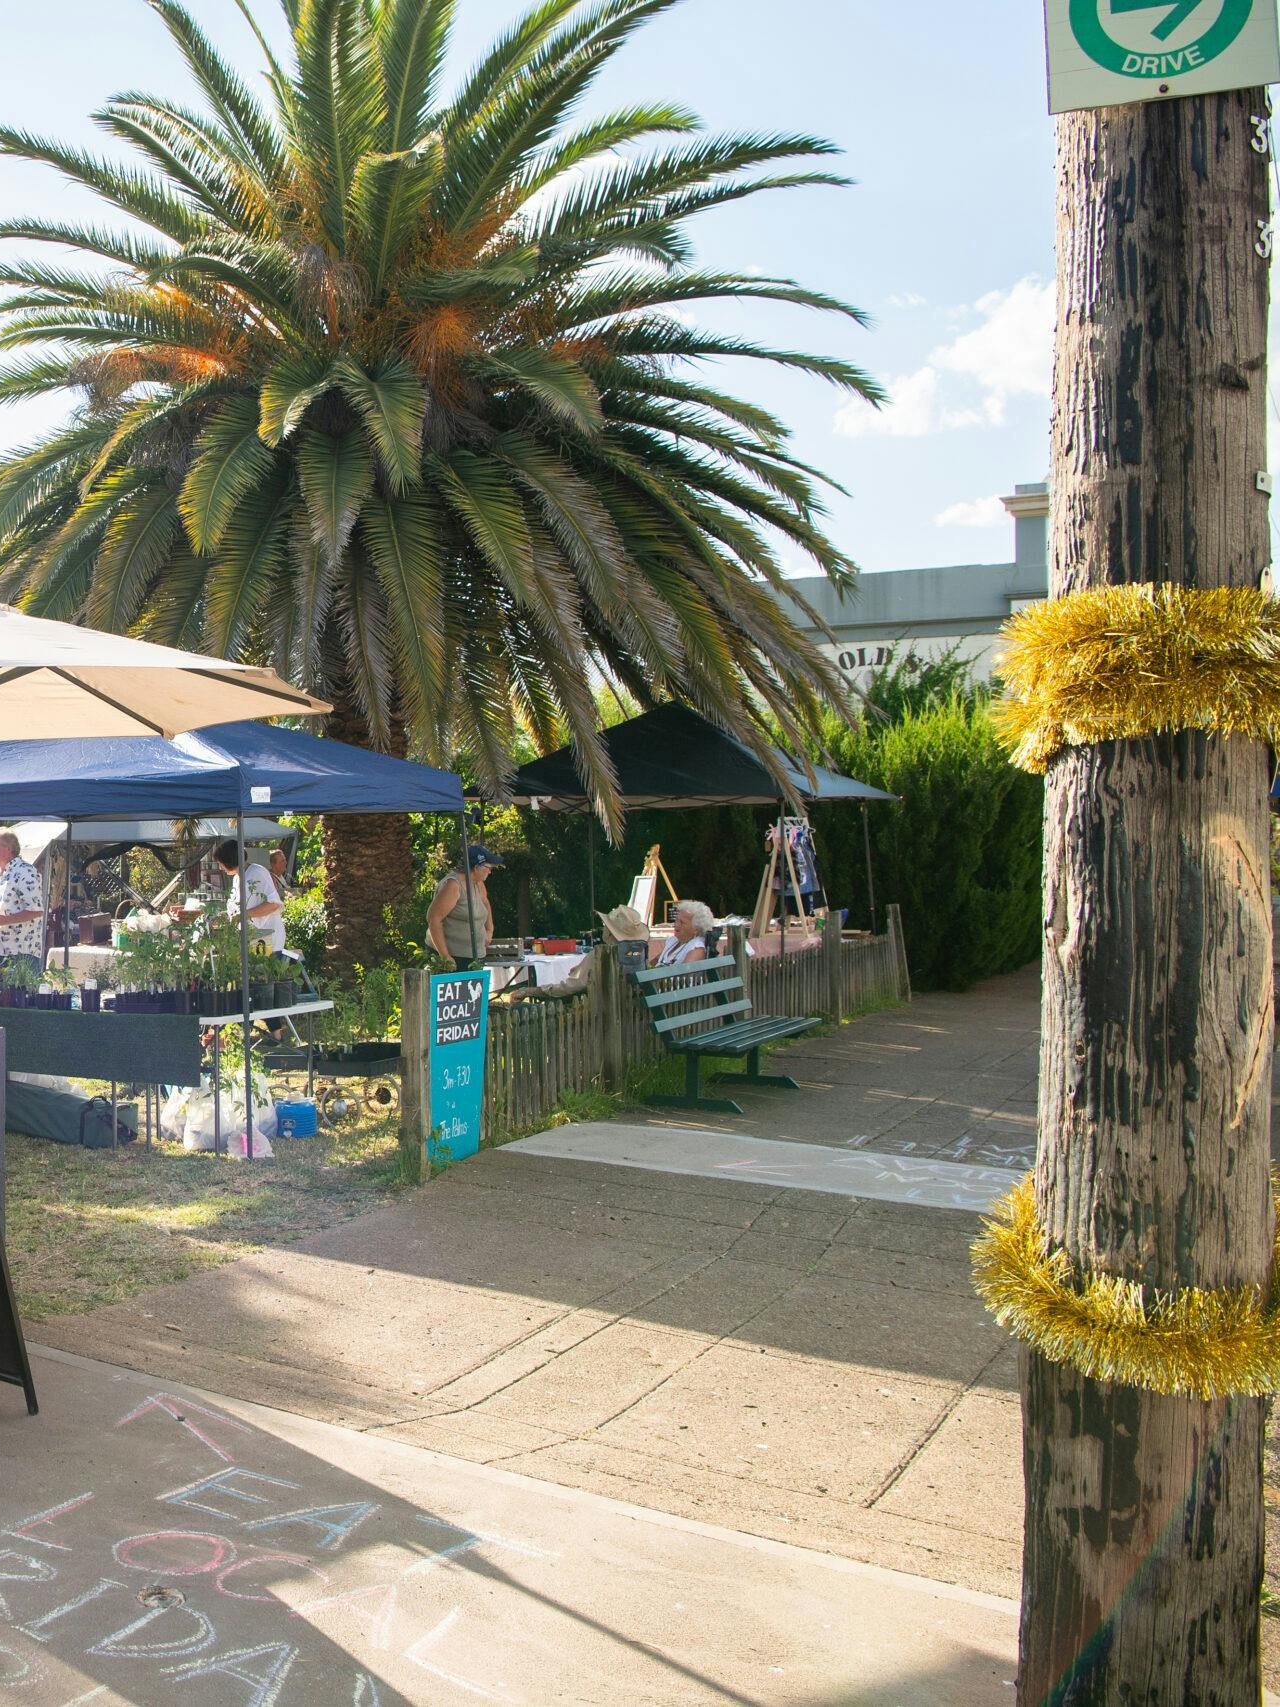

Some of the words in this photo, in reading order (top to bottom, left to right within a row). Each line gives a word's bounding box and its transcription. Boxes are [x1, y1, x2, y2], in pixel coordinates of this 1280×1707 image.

[1122, 45, 1205, 74] DRIVE
[437, 982, 462, 1003] EAT
[436, 1002, 471, 1023] LOCAL
[436, 1022, 479, 1044] FRIDAY
[156, 1465, 562, 1580] EAT
[0, 1490, 520, 1704] LOCAL
